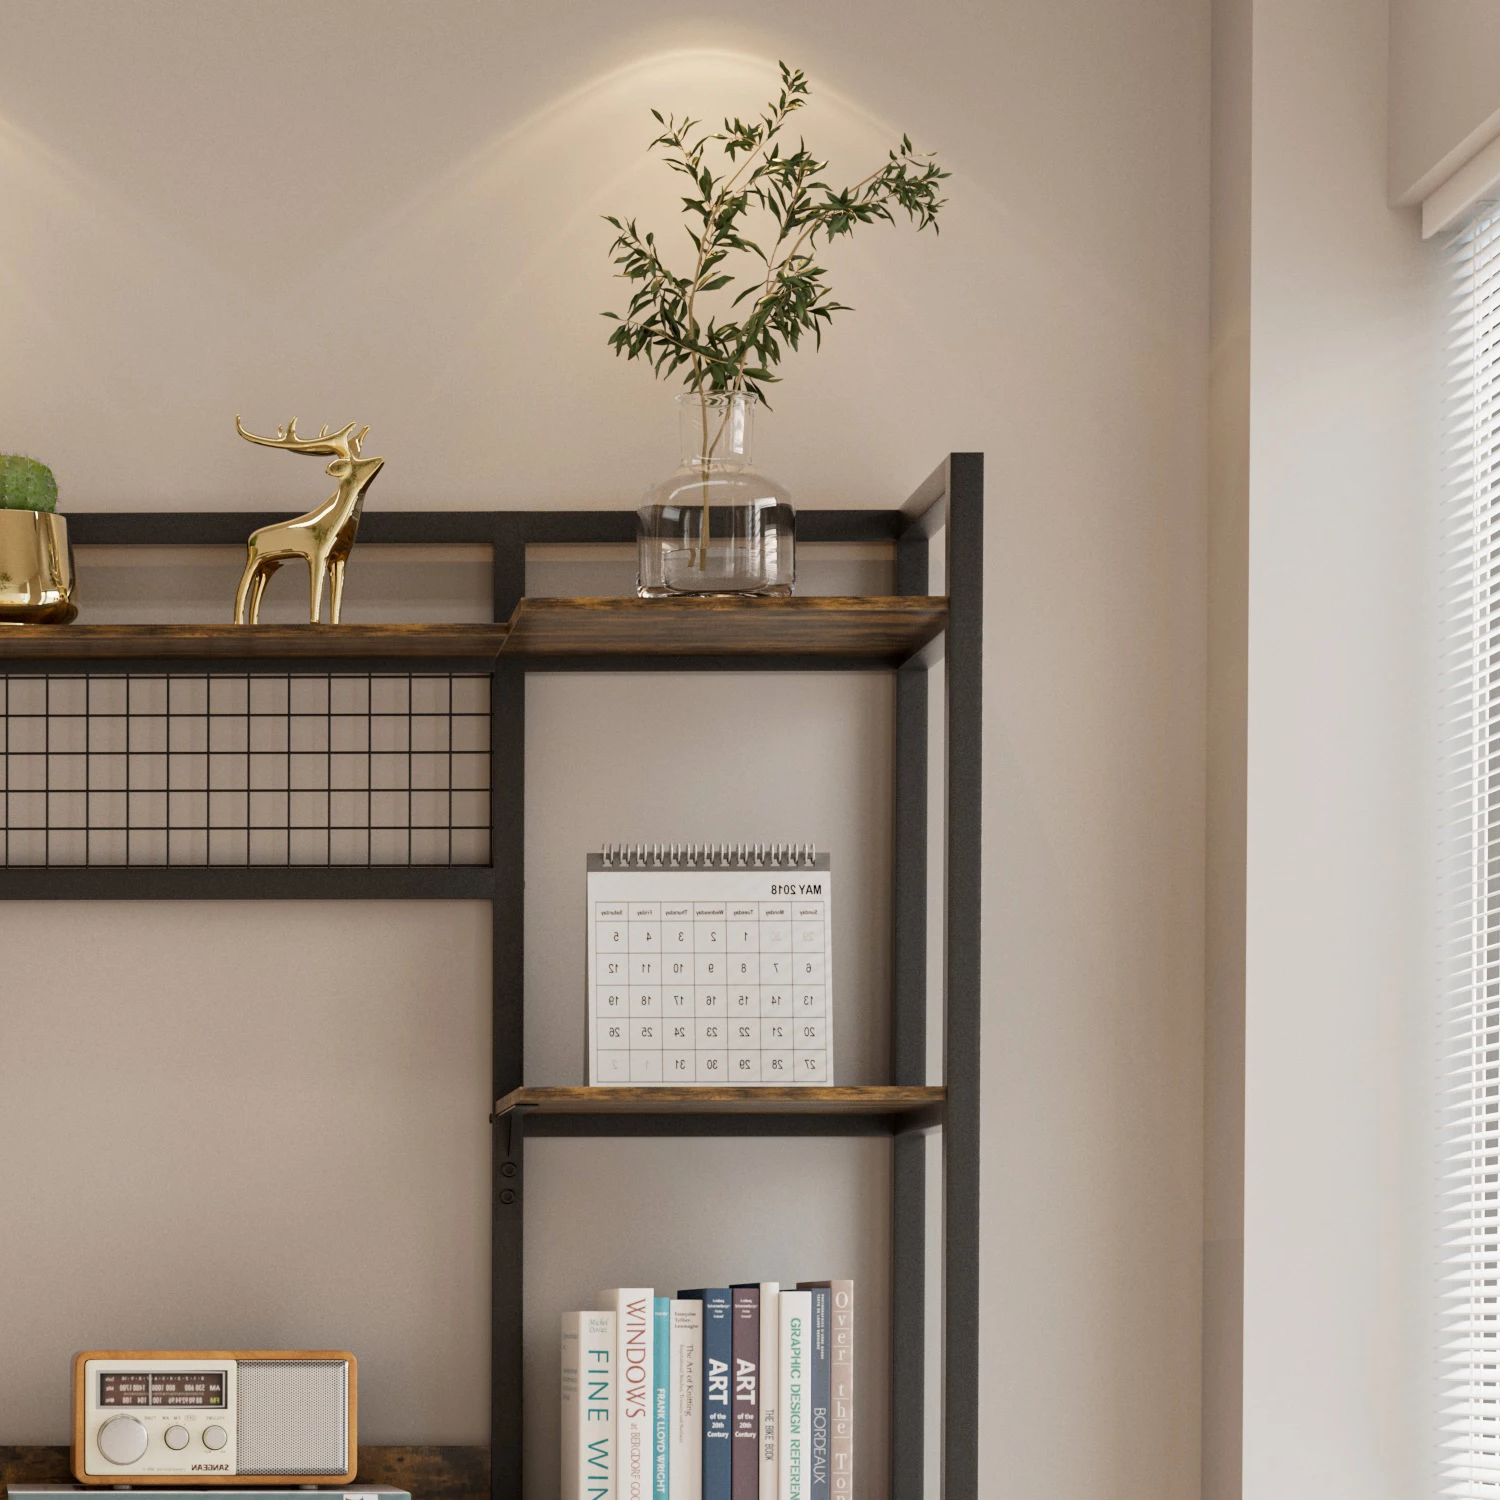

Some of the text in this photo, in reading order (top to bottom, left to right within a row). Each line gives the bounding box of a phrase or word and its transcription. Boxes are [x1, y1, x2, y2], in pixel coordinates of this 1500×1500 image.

[686, 1344, 694, 1358] The
[790, 1317, 802, 1379] GRAPHIC
[835, 1291, 849, 1361] Over
[626, 1298, 646, 1418] WINDOWS
[686, 1360, 694, 1372] Art
[709, 1358, 728, 1406] ART
[736, 1358, 756, 1406] ART
[588, 1350, 609, 1421] FINE
[685, 1382, 694, 1416] Knitting
[790, 1384, 801, 1434] DESIGN
[836, 1383, 847, 1434] the
[630, 1432, 641, 1479] BERGDORF
[656, 1388, 666, 1494] FRANK LLOYD WRIGHT
[707, 1431, 730, 1439] Century
[735, 1431, 757, 1439] Century
[765, 1410, 774, 1461] THE BIKE BOOK
[813, 1407, 827, 1484] BORDEAUX
